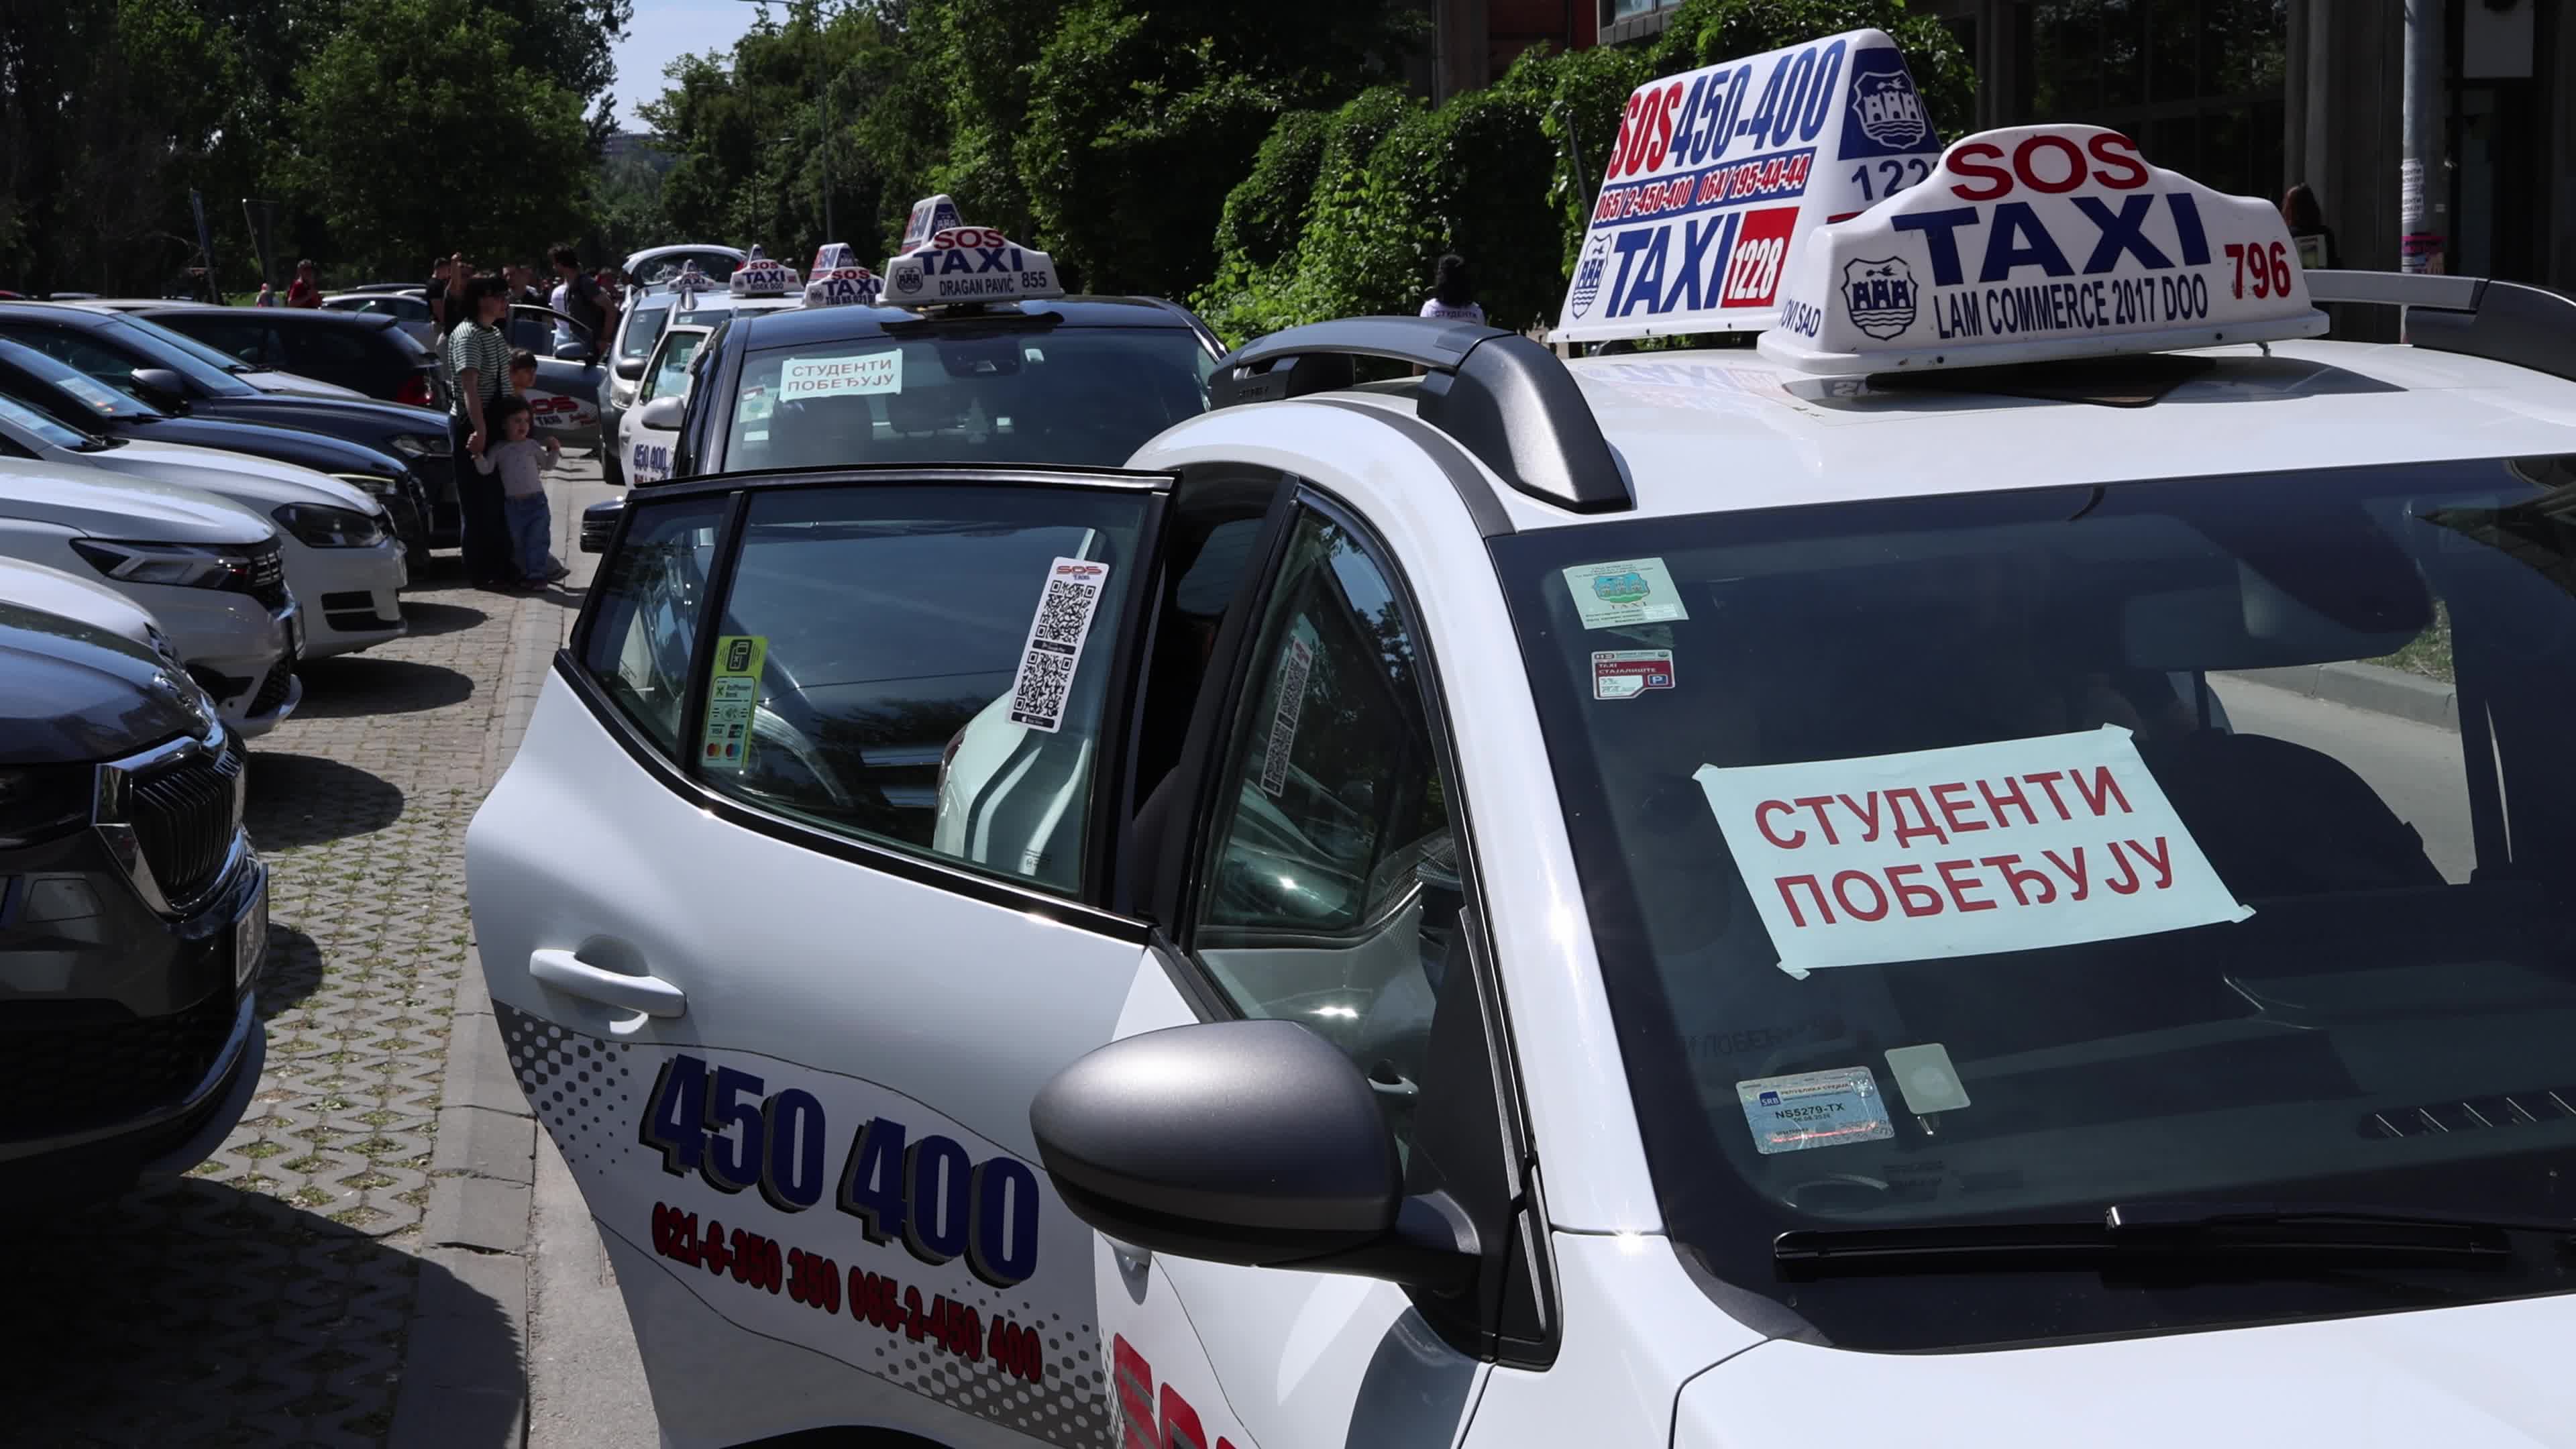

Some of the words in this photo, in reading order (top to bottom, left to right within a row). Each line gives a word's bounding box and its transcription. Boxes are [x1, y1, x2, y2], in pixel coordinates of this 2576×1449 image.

[1609, 81, 1682, 180] SOS
[1670, 39, 1846, 168] 450-400
[1851, 158, 1937, 201] 122
[1947, 133, 2149, 201] SOS
[934, 229, 1004, 250] SOS
[1891, 193, 2211, 287] TAXI
[743, 271, 786, 284] TAXI
[832, 270, 870, 280] SOS
[913, 248, 1024, 276] TAXI
[1605, 213, 1741, 318] TAXI
[1727, 237, 1784, 300] 1228
[2225, 241, 2292, 301] 796
[822, 279, 881, 295] TAXI
[939, 278, 983, 296] DRAGAN
[1022, 272, 1046, 288] 855
[1794, 303, 1821, 337] SAD
[1933, 290, 1983, 339] LAM
[1986, 280, 2110, 335] COMMERCE
[2112, 278, 2155, 325] 2017
[2162, 274, 2208, 321] DOO
[788, 374, 895, 392] ПОБЕЂУЈУ
[792, 360, 892, 377] СТУДЕНТИ
[1056, 566, 1102, 574] SOS
[1755, 766, 2133, 850] СТУДЕНТИ
[1774, 837, 2174, 927] ПОБЕЂУЈУ
[1762, 1098, 1779, 1106] SRB
[1775, 1103, 1845, 1120] NS5279-TX
[639, 1053, 826, 1213] 450
[836, 1116, 1039, 1289] 400
[787, 1247, 841, 1314] 350
[988, 1314, 1042, 1385] 400
